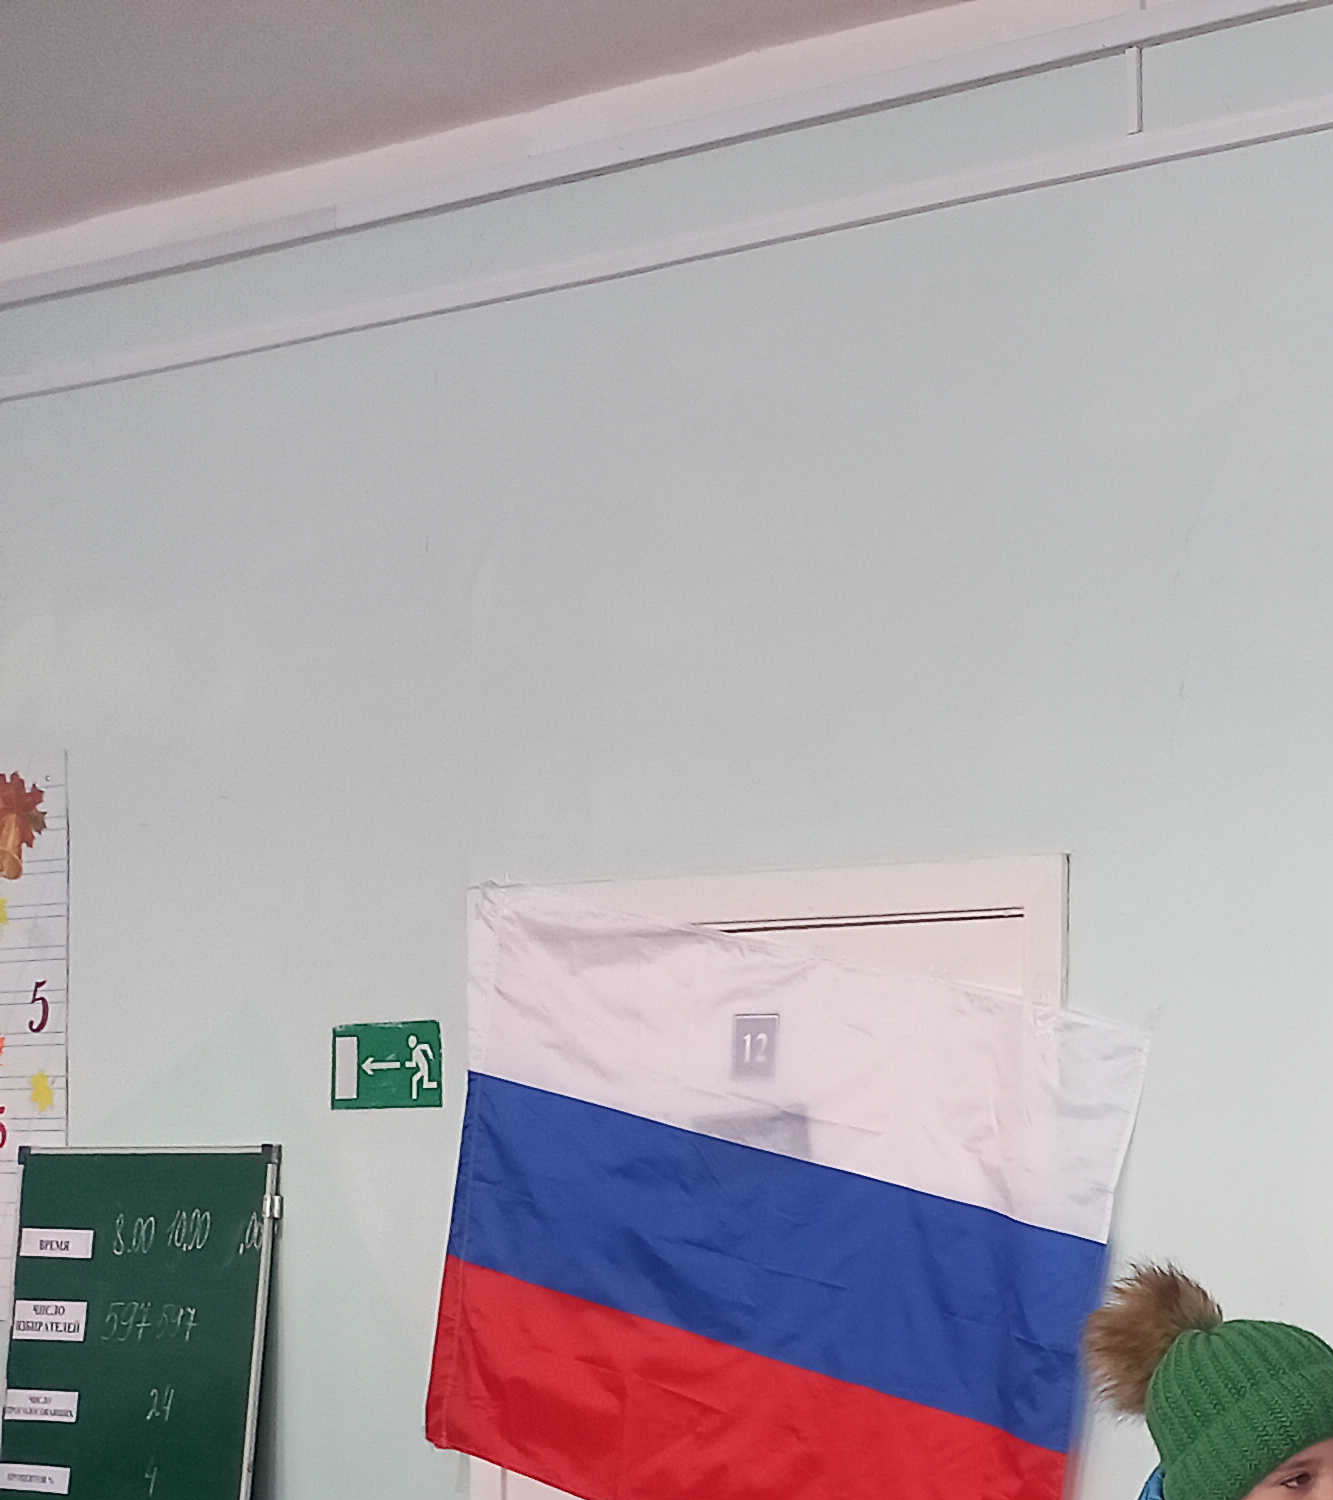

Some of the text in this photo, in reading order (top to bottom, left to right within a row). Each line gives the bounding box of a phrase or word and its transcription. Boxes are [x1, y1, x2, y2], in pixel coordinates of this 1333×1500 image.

[28, 980, 50, 1033] 5
[743, 1032, 768, 1063] 12
[146, 1385, 175, 1421] 24
